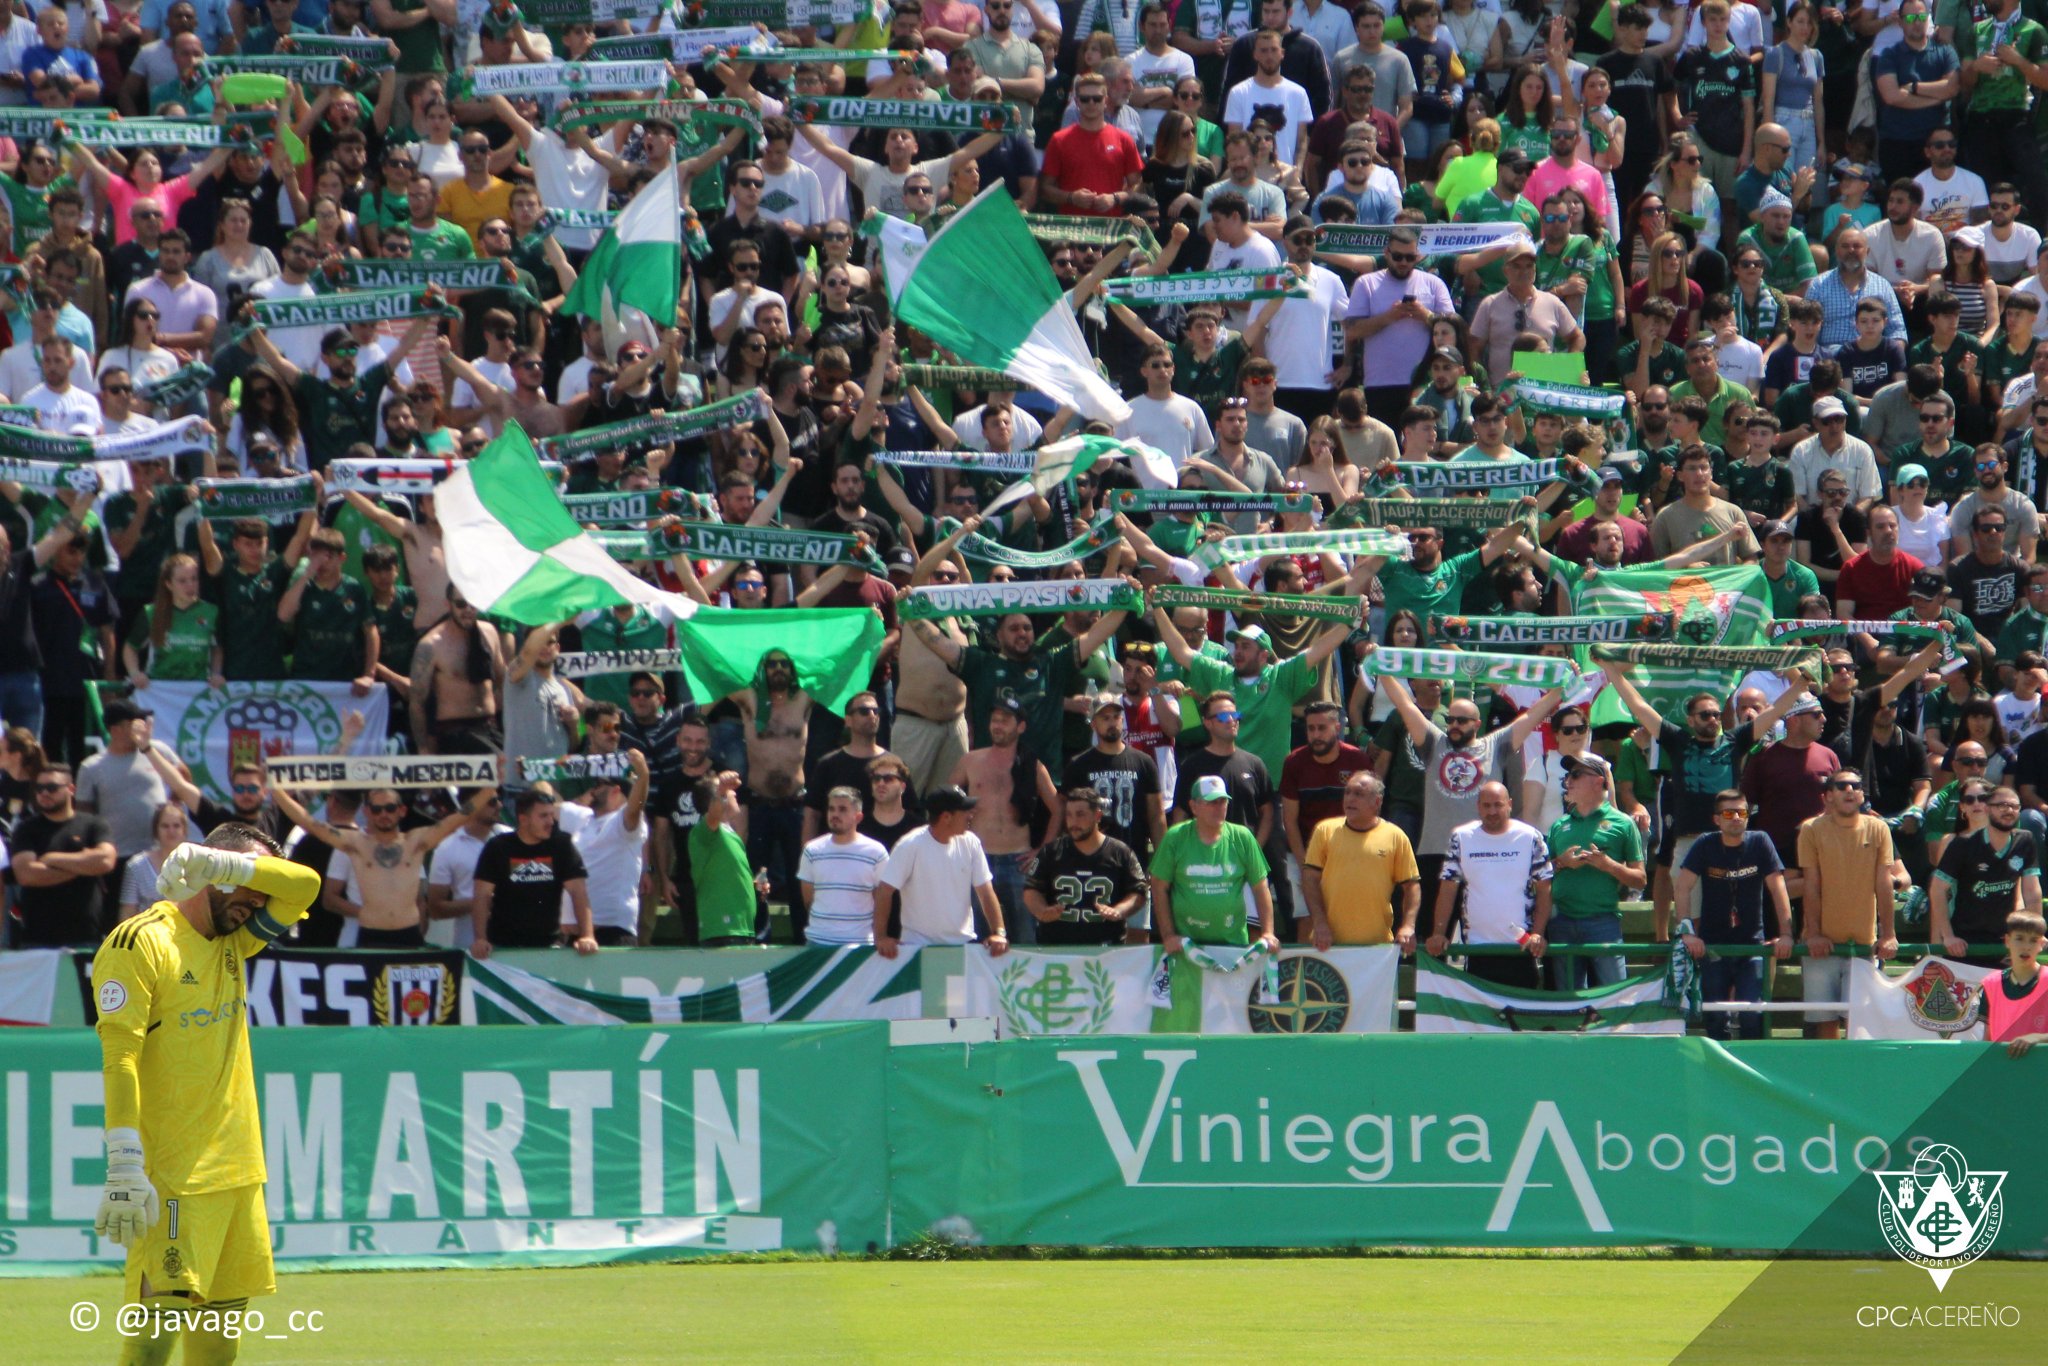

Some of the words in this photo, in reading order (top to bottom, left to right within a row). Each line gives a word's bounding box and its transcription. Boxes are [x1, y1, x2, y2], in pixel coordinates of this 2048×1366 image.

[828, 98, 972, 126] CACEREÑO
[80, 123, 221, 145] CACEREÑO
[1349, 233, 1390, 247] CACERE
[354, 263, 501, 289] CACEREÑO
[1134, 275, 1252, 296] CACEREÑO
[265, 292, 411, 326] CACEREÑO
[1518, 377, 1540, 388] Club
[1546, 382, 1609, 397] Polideportivo
[1410, 457, 1557, 487] CACEREÑO
[1144, 502, 1157, 511] LOS
[1158, 502, 1168, 511] DE
[1169, 502, 1196, 511] ARRIBA
[1196, 502, 1209, 511] DEL
[1222, 502, 1239, 511] LUIS
[697, 529, 843, 562] CACEREÑO
[932, 591, 993, 612] UNA
[1001, 582, 1111, 609] PASIÓN
[1479, 617, 1629, 643] CACEREÑO
[268, 763, 347, 784] TIFOS
[391, 761, 495, 783] MERIDA
[1089, 770, 1139, 781] BALENCIAGA
[1469, 851, 1500, 859] FRESH
[1500, 850, 1521, 858] OUT
[518, 873, 554, 883] Columbia
[265, 1033, 762, 1222] MARTÍN
[1057, 1049, 1492, 1187] Viniegra
[1486, 1100, 1938, 1233] Abogados
[166, 1199, 179, 1240] 1
